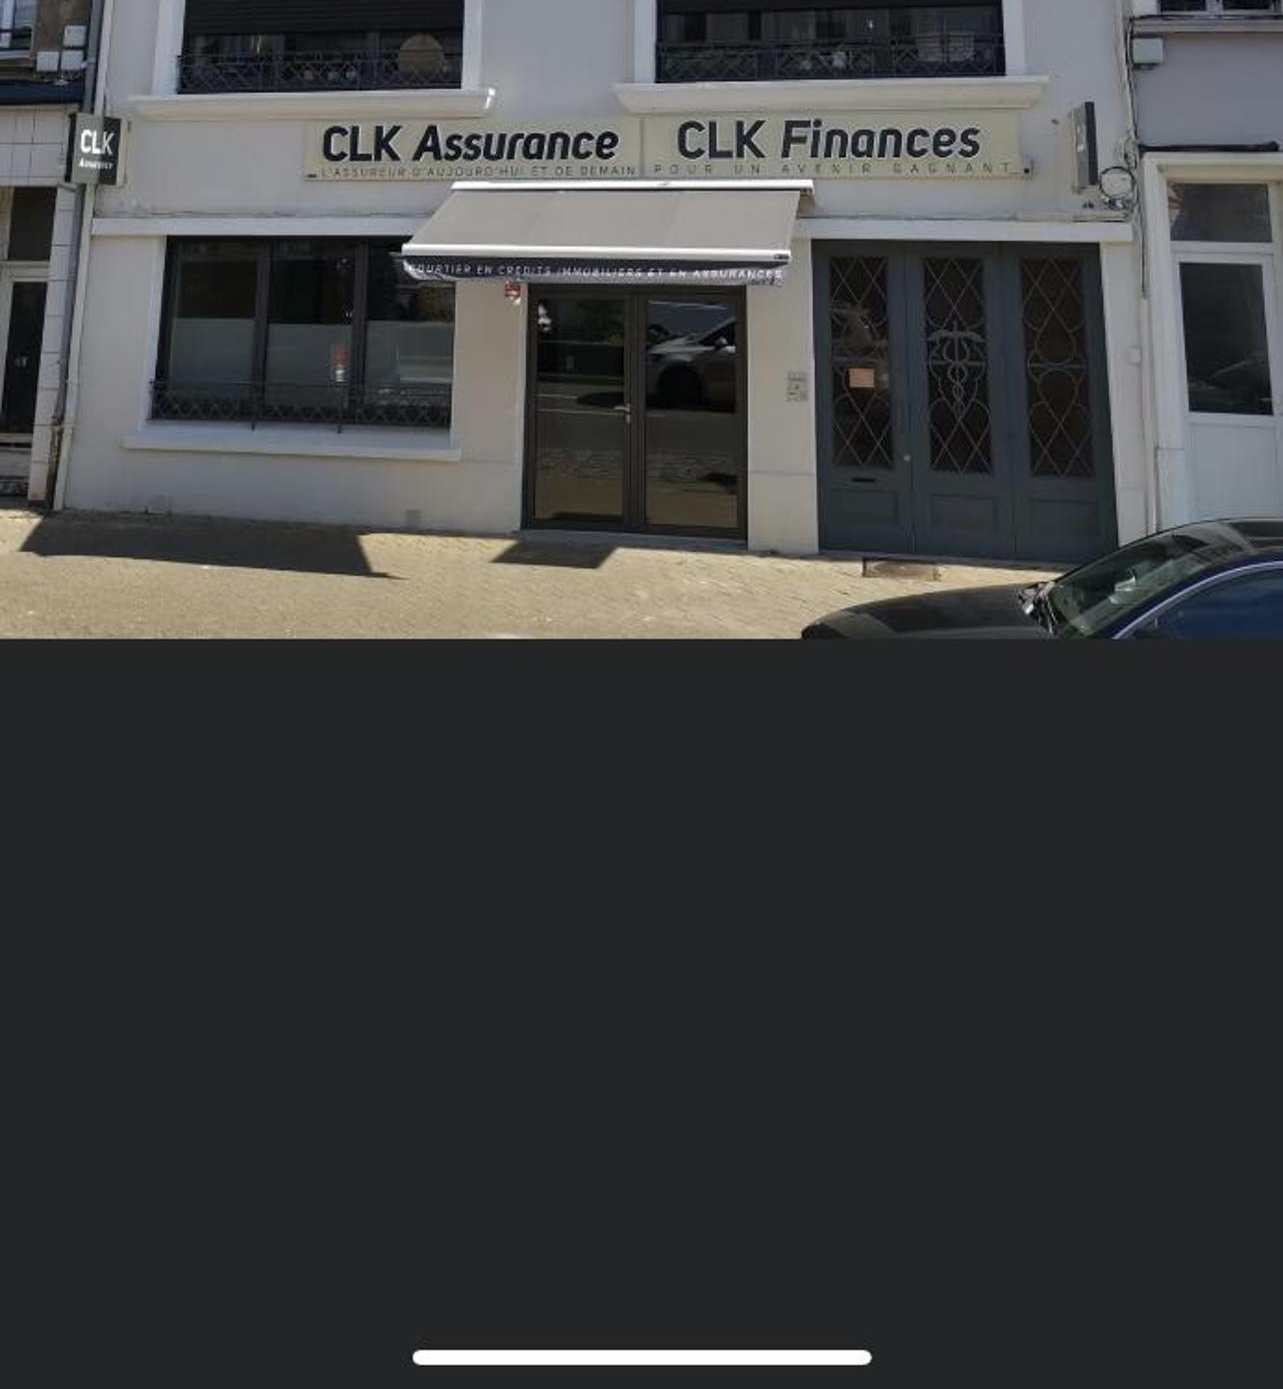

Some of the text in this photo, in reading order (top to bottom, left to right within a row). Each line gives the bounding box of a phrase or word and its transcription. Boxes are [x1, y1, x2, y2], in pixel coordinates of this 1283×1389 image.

[81, 129, 115, 155] CLK
[322, 124, 620, 162] CLK Assurance
[676, 118, 981, 160] CLK Finances
[321, 167, 405, 178] L'ASSUREUR
[531, 166, 549, 177] ET
[555, 166, 574, 177] DE
[580, 166, 636, 177] DEMAIN
[654, 162, 1010, 174] POUR UN AVENIR GAGNANT
[692, 269, 783, 279] ASSURANCES
